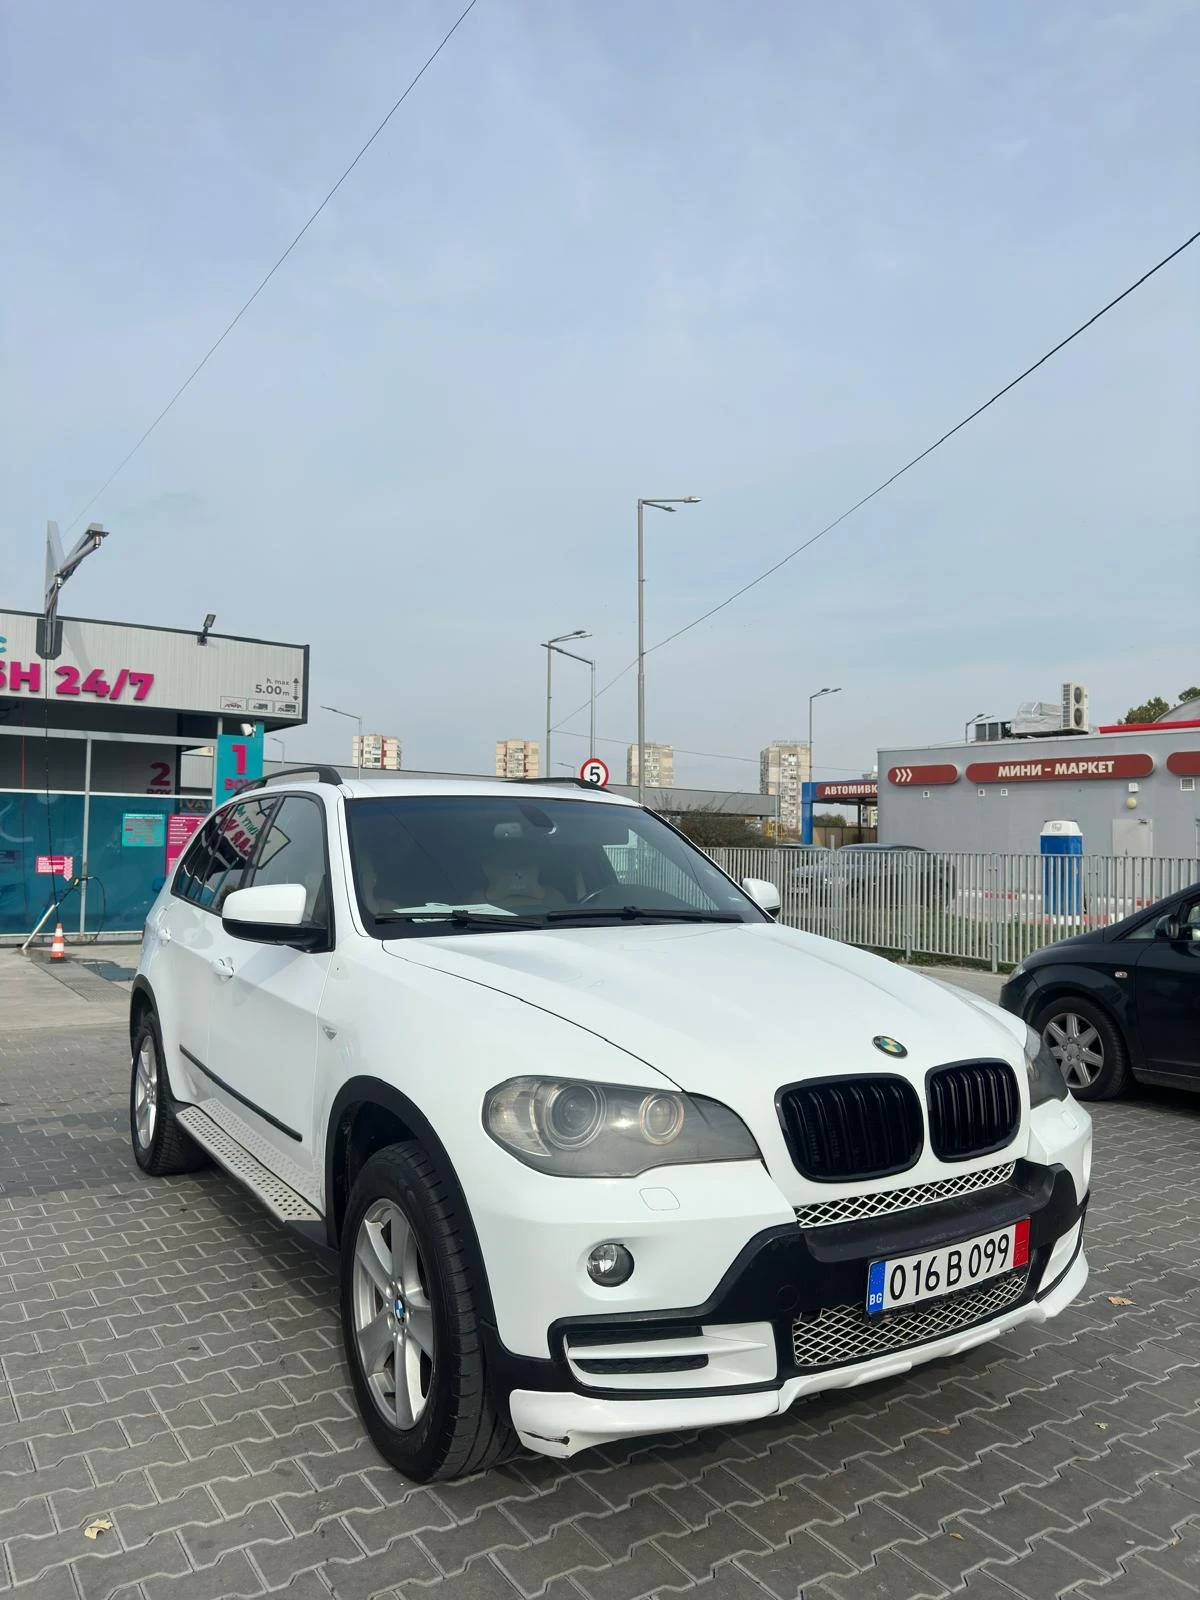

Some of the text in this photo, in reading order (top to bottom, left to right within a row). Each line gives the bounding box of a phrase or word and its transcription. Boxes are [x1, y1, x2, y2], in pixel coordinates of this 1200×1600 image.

[0, 660, 154, 700] H 24/7
[231, 744, 247, 775] 1
[998, 765, 1042, 778] МИНИ
[1054, 761, 1115, 775] МАРКЕТ
[150, 762, 171, 786] 2
[589, 766, 601, 784] 5
[869, 1292, 882, 1305] BG
